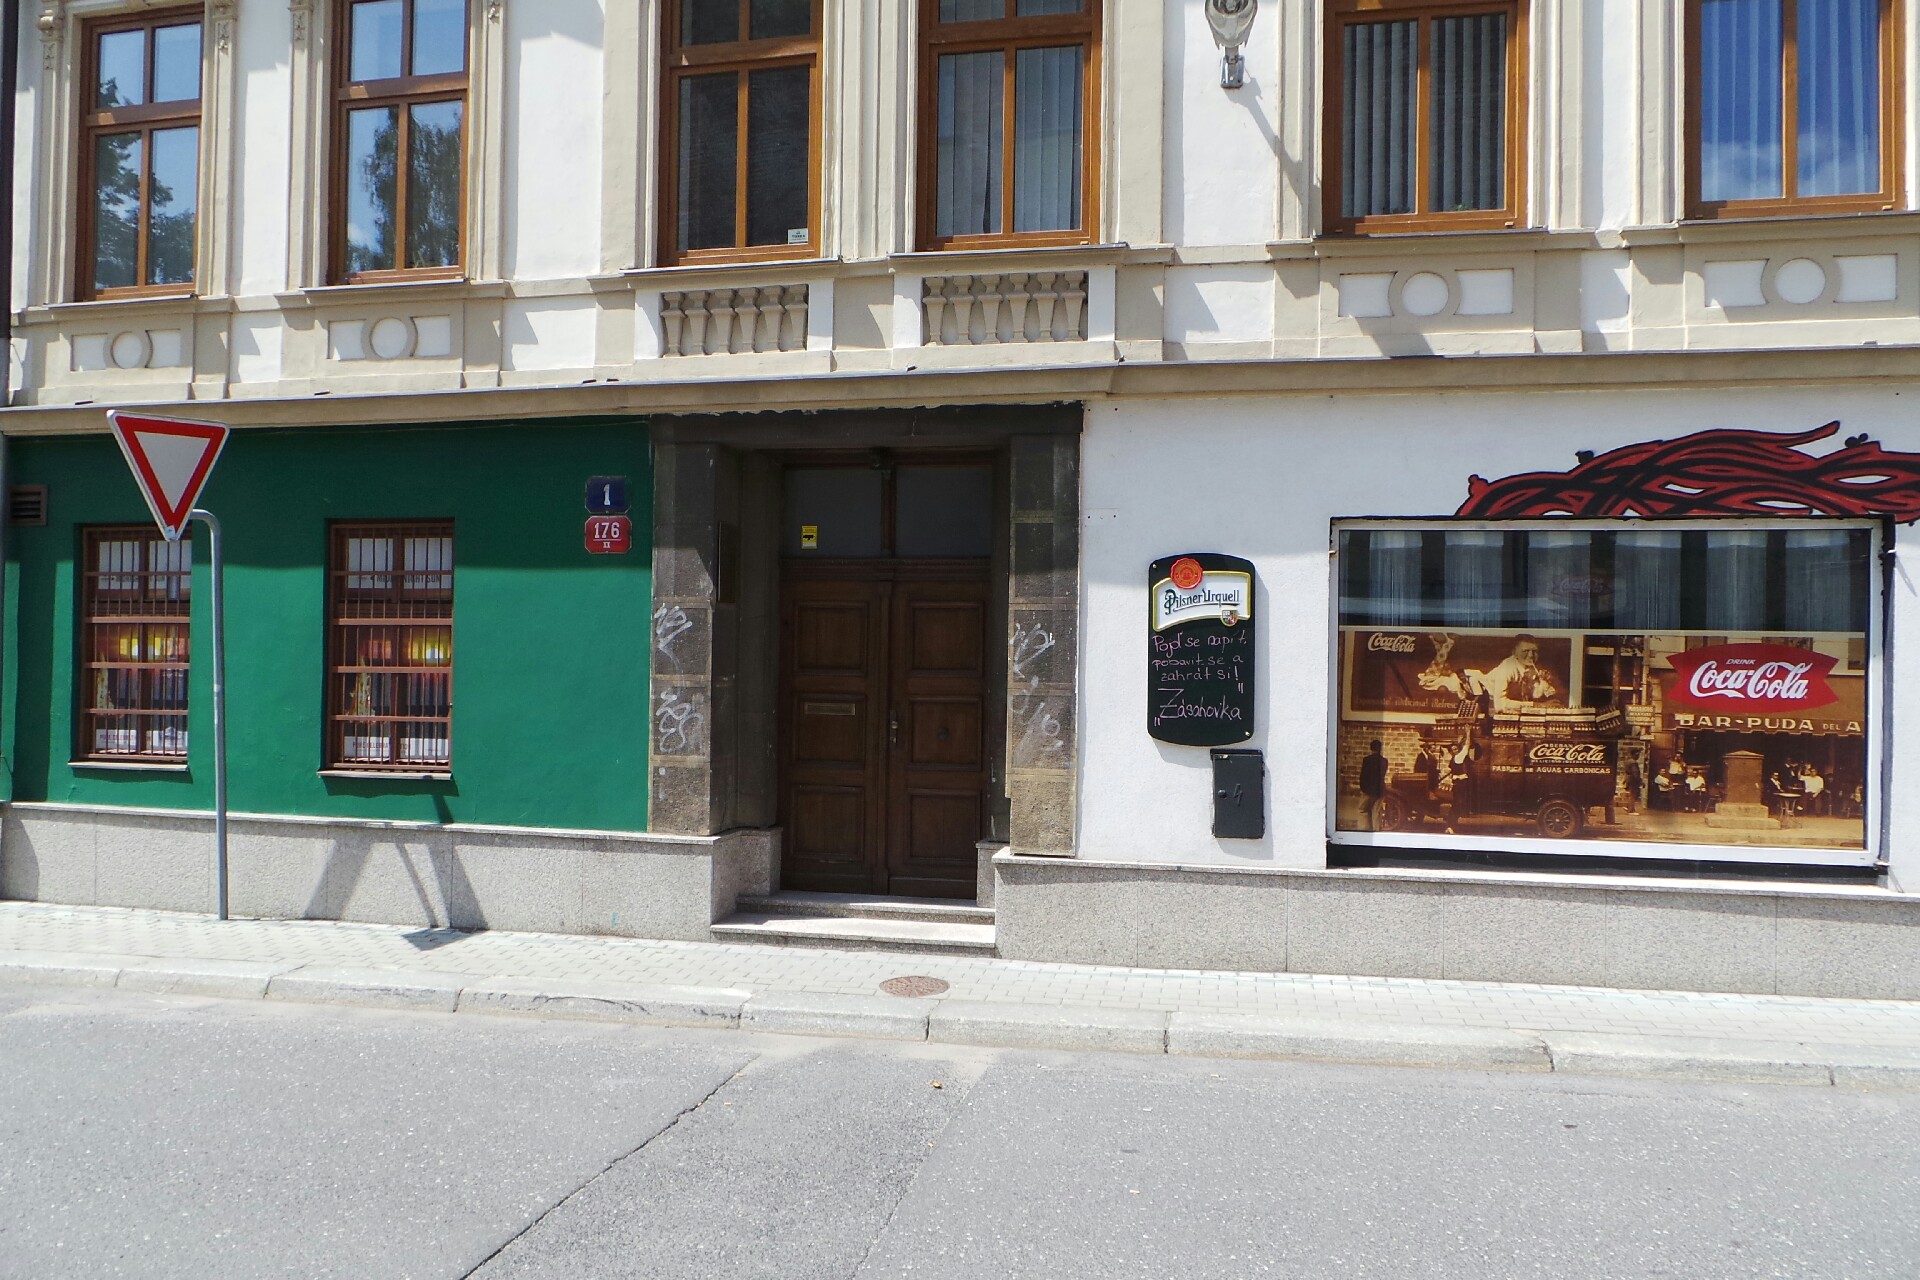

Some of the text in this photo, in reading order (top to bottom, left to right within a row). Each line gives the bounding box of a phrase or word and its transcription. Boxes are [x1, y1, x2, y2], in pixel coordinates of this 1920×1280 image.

[603, 483, 611, 506] 1
[594, 521, 620, 539] 176
[1164, 588, 1240, 615] Pilsner Urquell
[1184, 637, 1201, 647] se
[1367, 632, 1417, 653] Coca-Cola
[1207, 656, 1225, 665] se
[1232, 655, 1244, 663] a
[1161, 665, 1239, 682] zahrát si!
[1689, 660, 1813, 700] Coca-Cola
[1822, 723, 1840, 731] DEL
[1845, 721, 1862, 732] A
[1529, 743, 1607, 761] Coca-Cola
[1492, 765, 1523, 773] FABRICA
[1536, 766, 1562, 774] AGUAS
